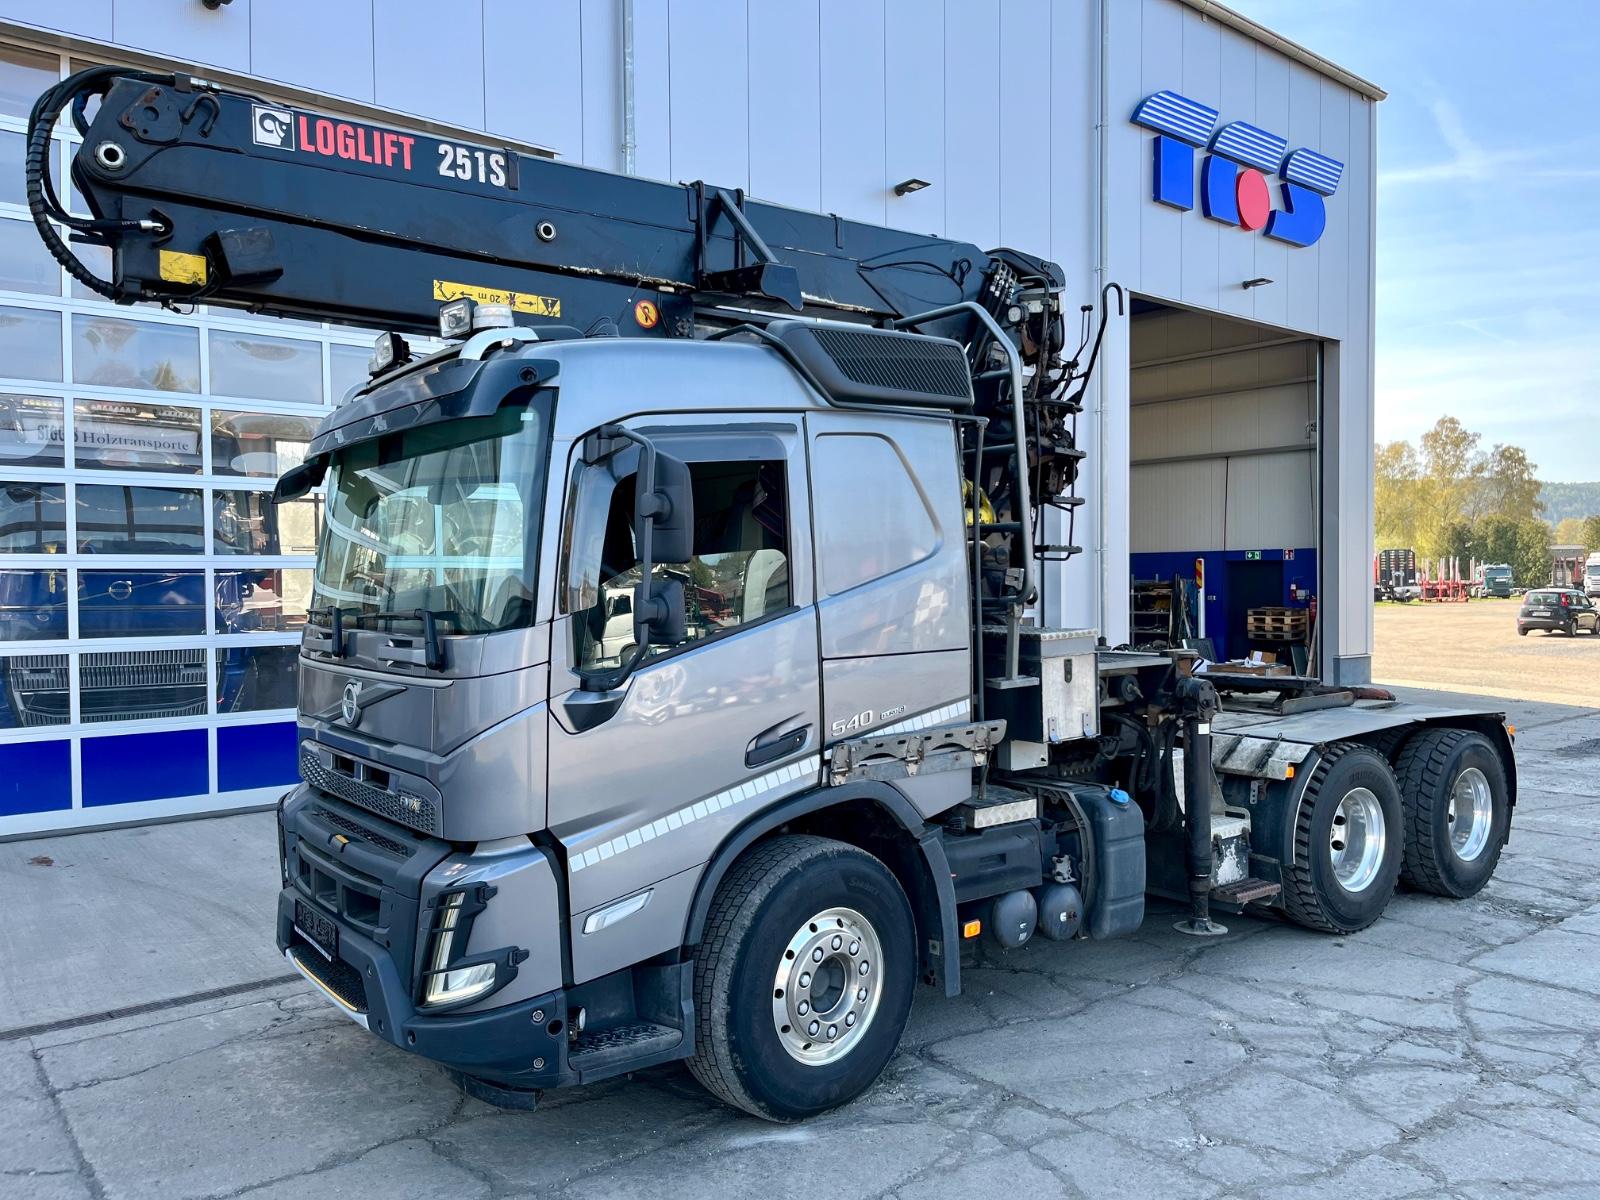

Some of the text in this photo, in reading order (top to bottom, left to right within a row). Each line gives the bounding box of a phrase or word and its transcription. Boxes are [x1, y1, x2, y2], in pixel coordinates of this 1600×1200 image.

[299, 115, 506, 187] LOGLIFT 251S
[490, 294, 501, 303] 20
[37, 424, 190, 451] SIGGS Holztransporte
[832, 709, 874, 737] 540
